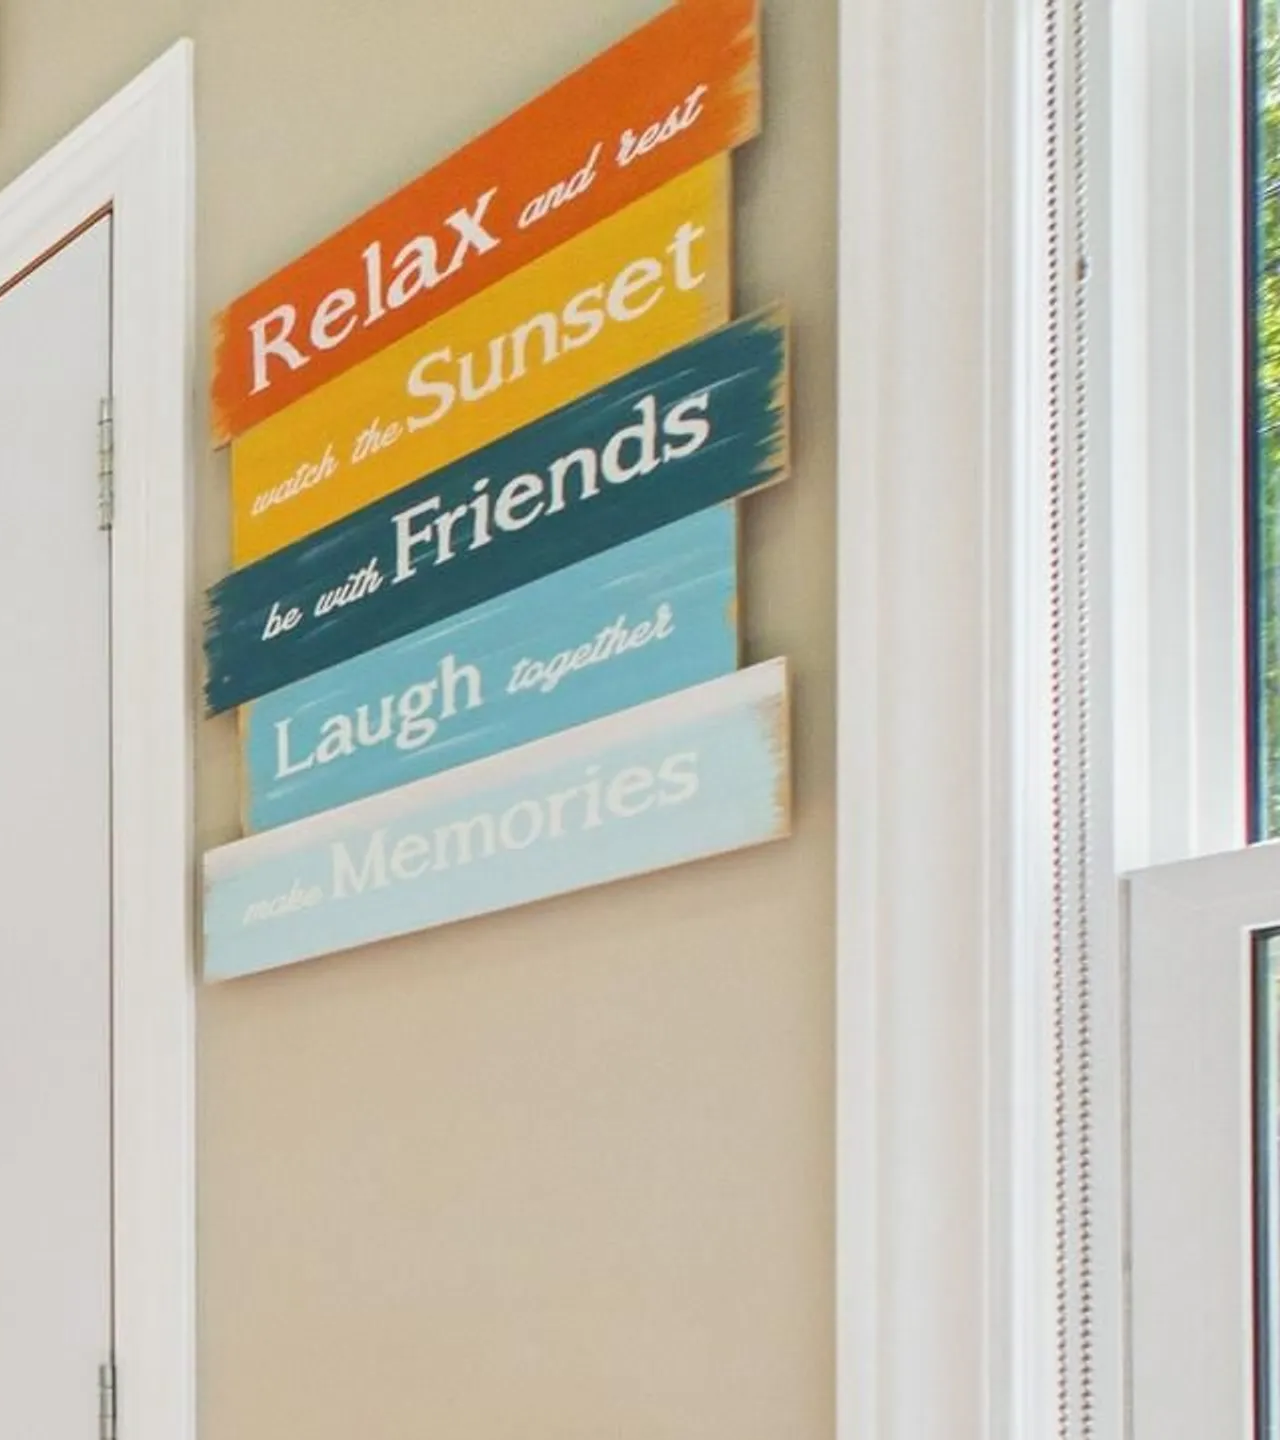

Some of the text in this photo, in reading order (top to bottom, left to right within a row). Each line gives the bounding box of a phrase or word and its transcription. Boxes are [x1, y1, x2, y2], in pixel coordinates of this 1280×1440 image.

[248, 84, 708, 397] Relax and rest
[251, 222, 705, 517] watch the Sunset
[262, 392, 710, 641] be with Friends
[274, 603, 674, 779] Laugh together
[243, 752, 699, 924] make Memories
